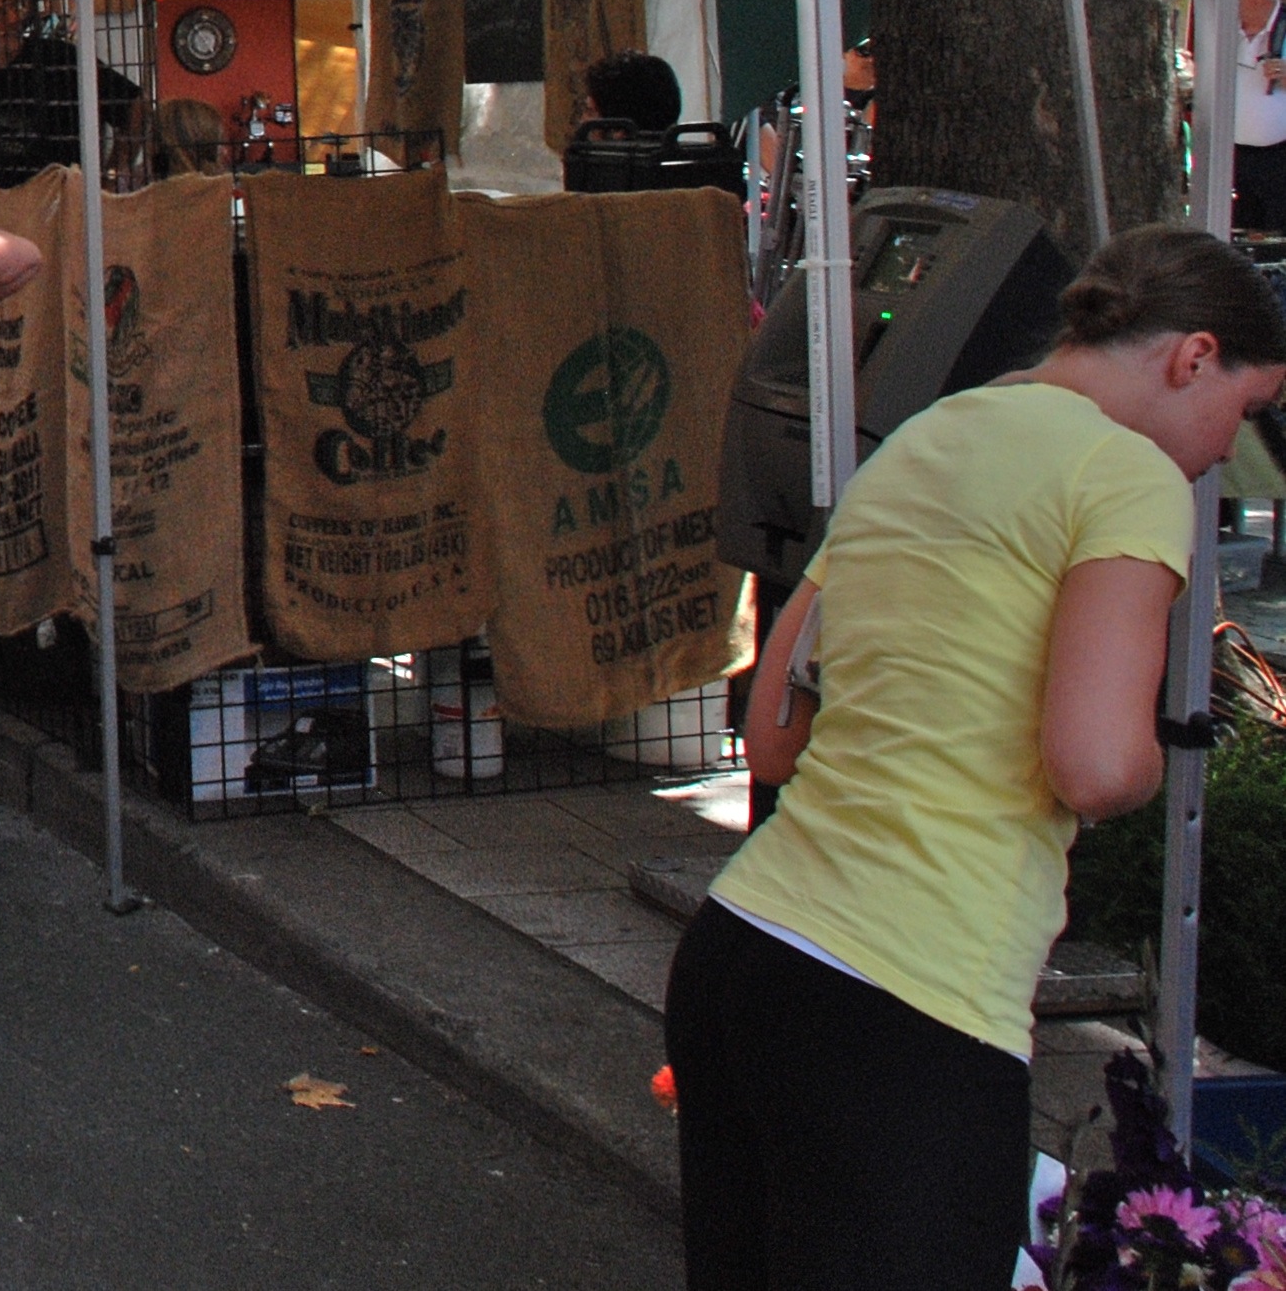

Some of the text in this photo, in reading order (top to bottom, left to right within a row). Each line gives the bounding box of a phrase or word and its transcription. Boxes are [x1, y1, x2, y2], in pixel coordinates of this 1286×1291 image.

[313, 428, 446, 486] Coffee
[544, 534, 642, 589] PRODUCT
[642, 521, 671, 559] OF
[676, 590, 719, 636] NET
